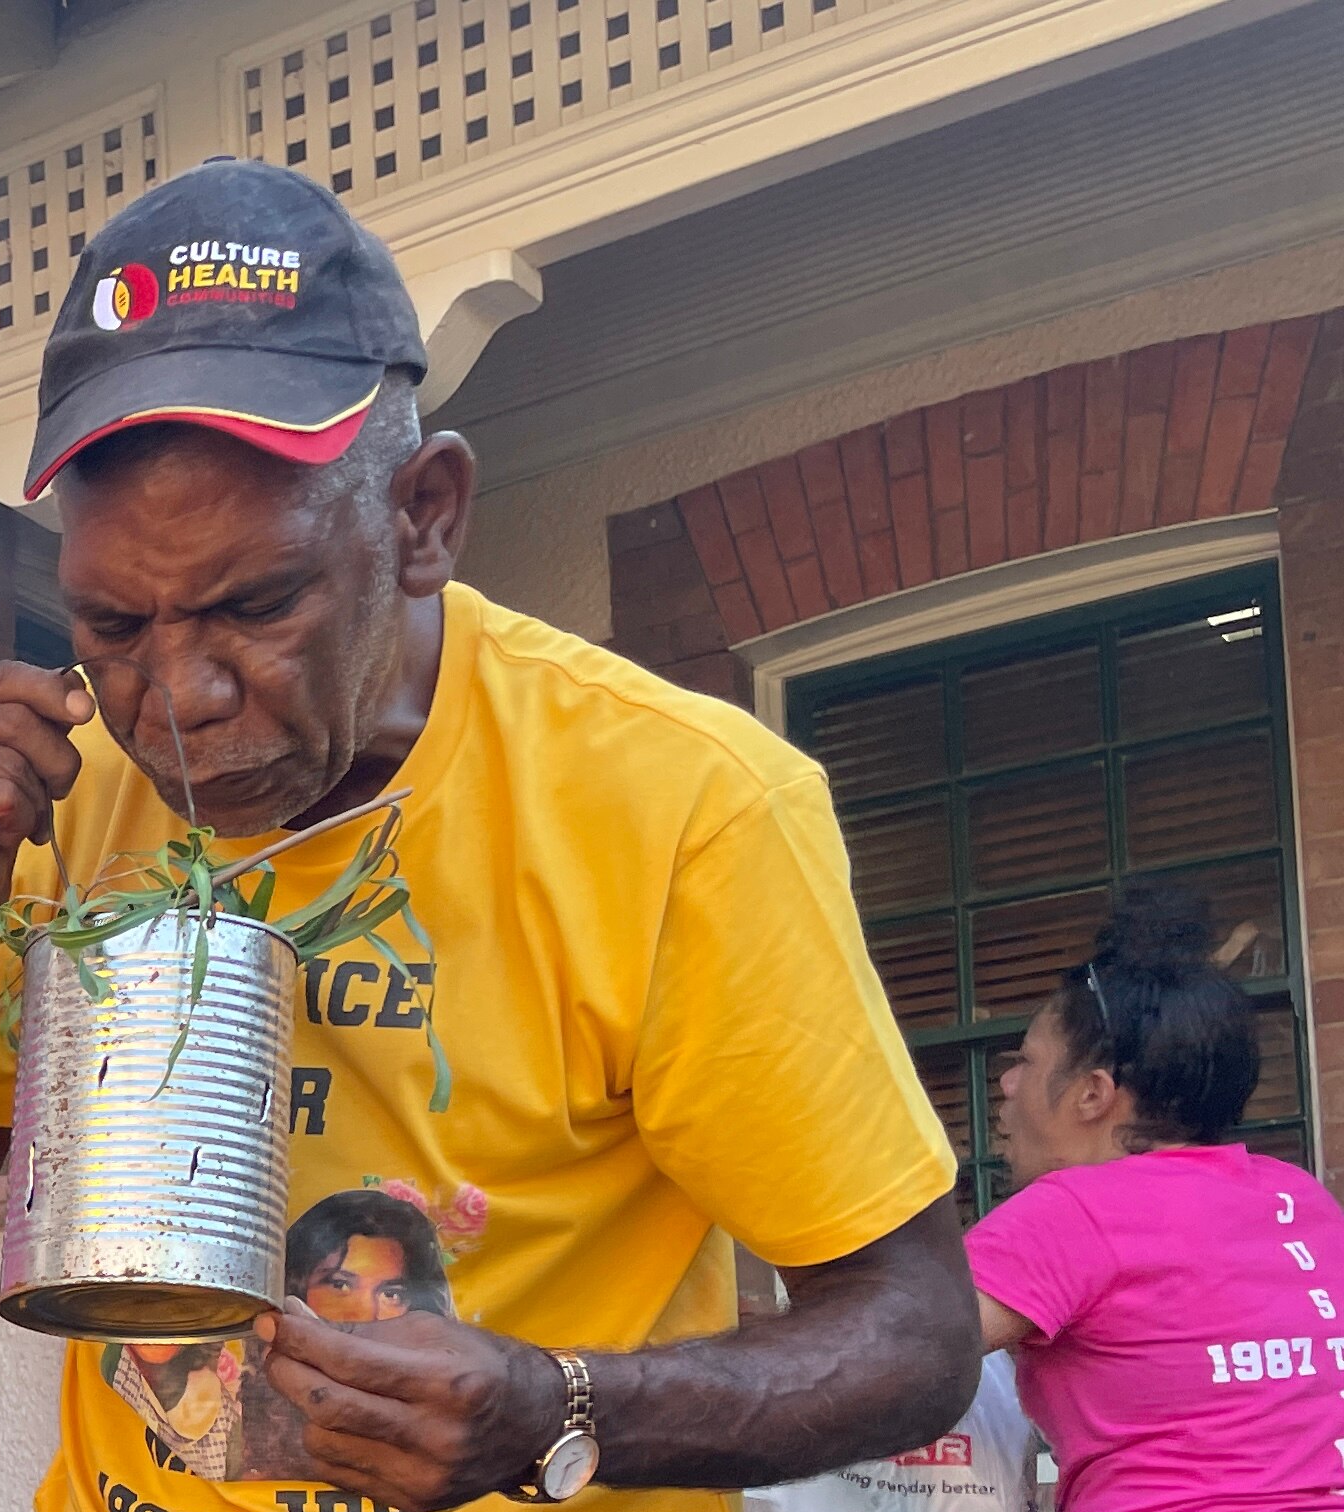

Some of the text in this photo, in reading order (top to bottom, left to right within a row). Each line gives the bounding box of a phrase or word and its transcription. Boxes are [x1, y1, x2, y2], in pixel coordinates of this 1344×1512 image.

[169, 240, 301, 269] CULTURE
[168, 263, 299, 293] HEALTH
[1207, 1337, 1317, 1383] 1987
[941, 1480, 997, 1495] better
